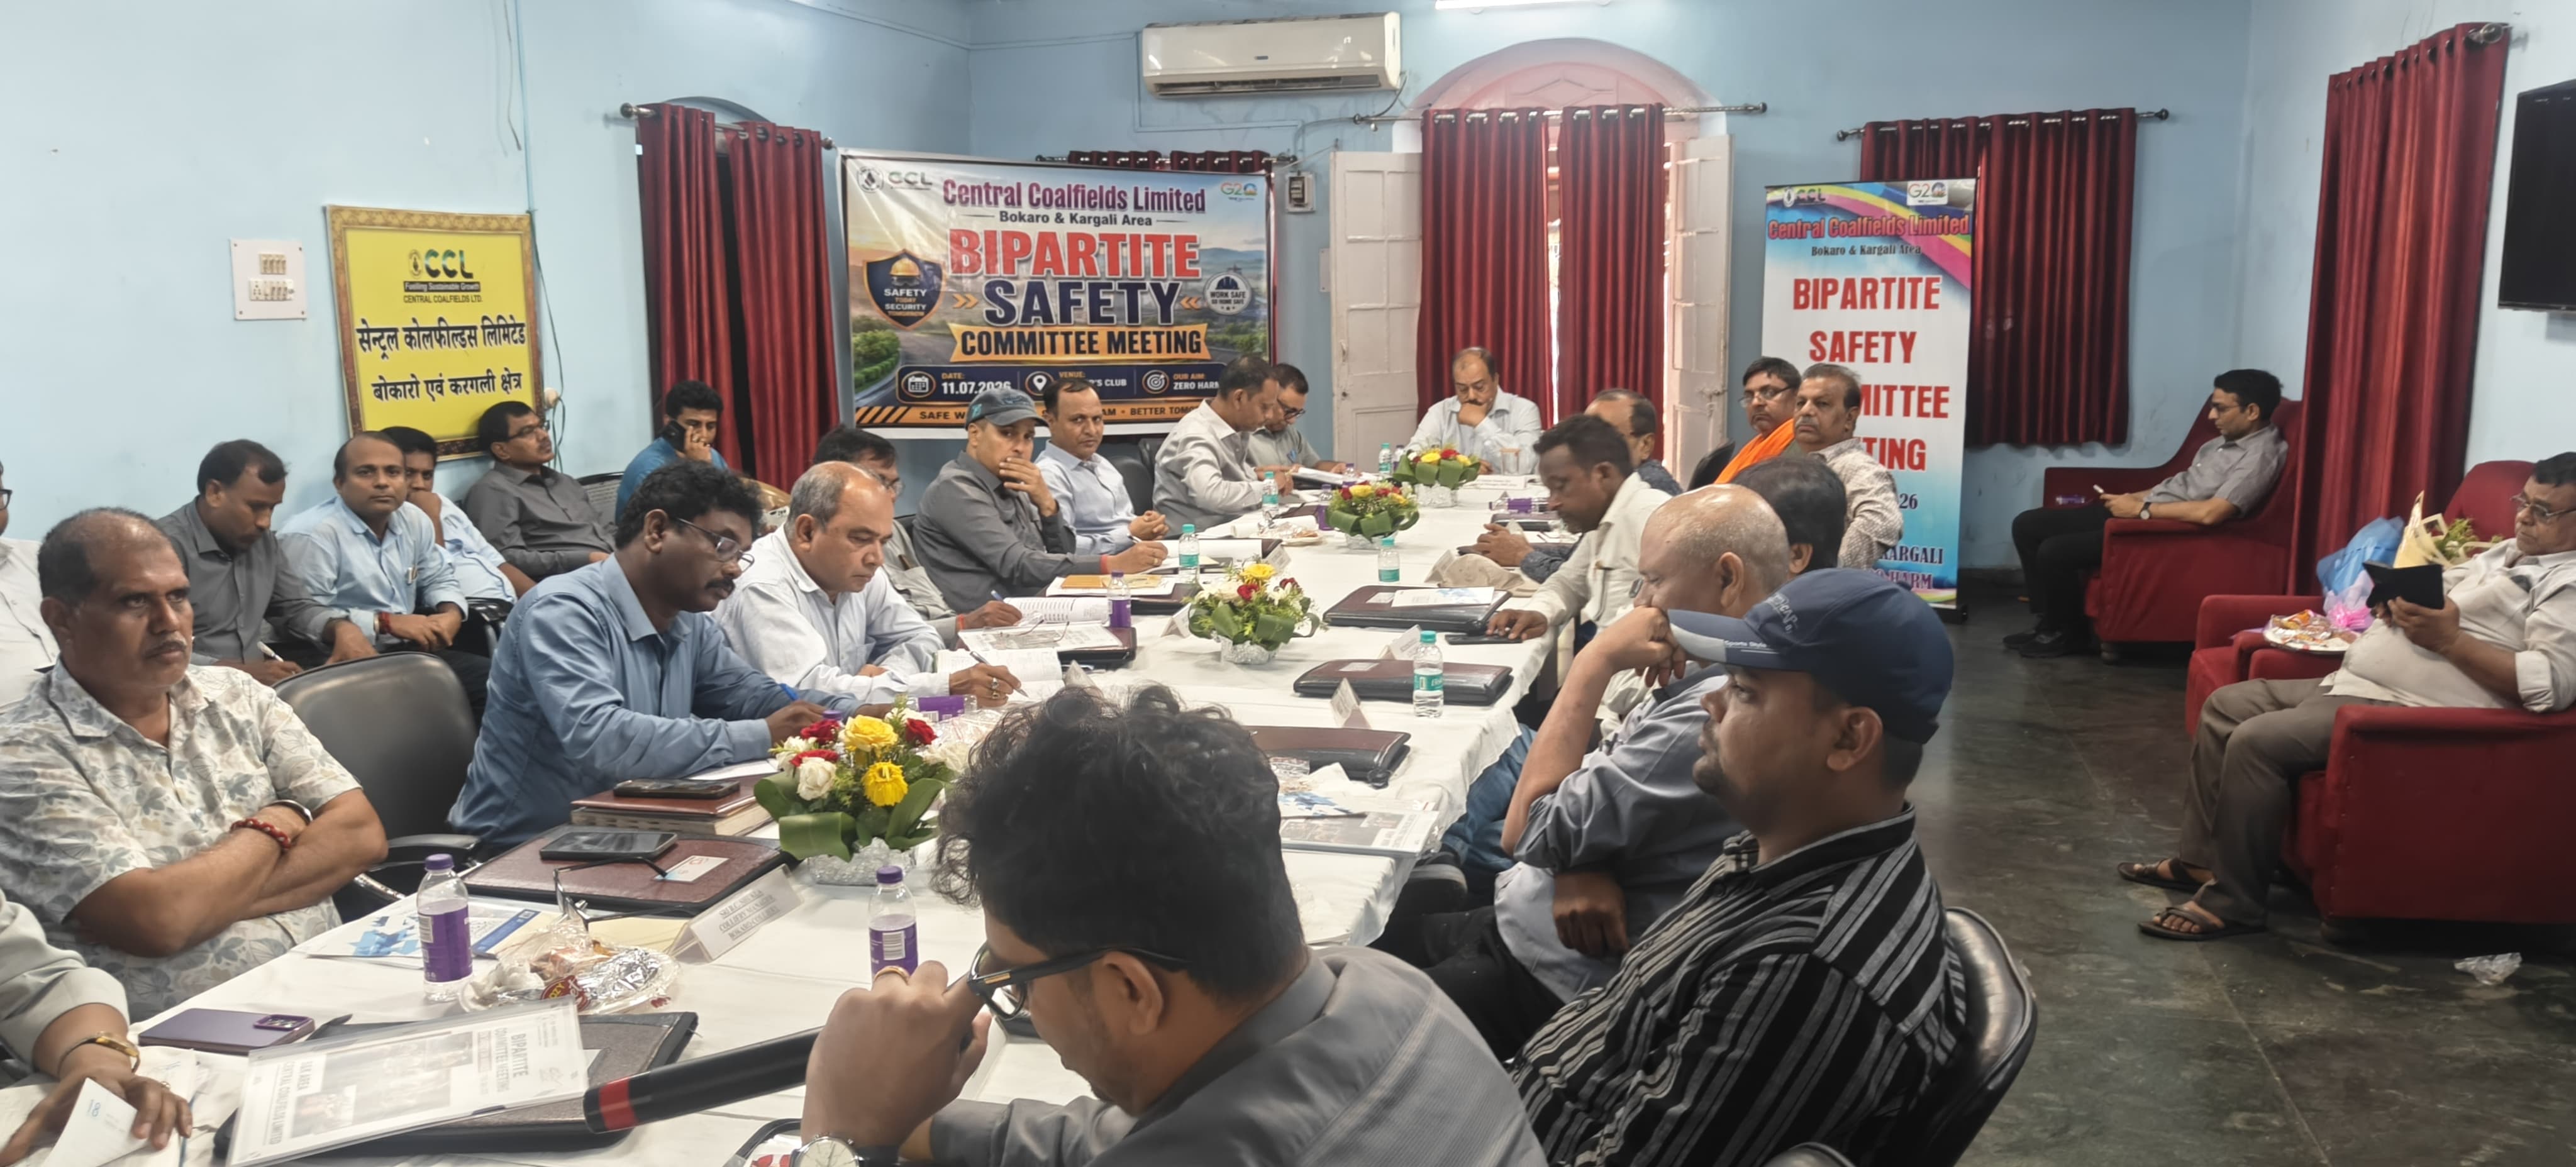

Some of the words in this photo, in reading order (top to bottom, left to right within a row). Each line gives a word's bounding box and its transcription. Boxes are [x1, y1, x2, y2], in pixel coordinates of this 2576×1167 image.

[888, 172, 933, 185] CCL
[943, 179, 1022, 208] Central
[1028, 182, 1128, 211] Coalfields
[1133, 186, 1206, 213] Limited
[1796, 188, 1826, 202] CCL
[999, 211, 1050, 223] Bokaro
[1055, 212, 1065, 224] &
[1070, 213, 1117, 227] Kargali
[1122, 214, 1152, 226] Area
[1768, 218, 1825, 240] Central
[1828, 216, 1906, 238] Coalfields
[1908, 214, 1970, 236] Limited
[425, 249, 474, 279] CCL
[949, 228, 1201, 277] BIPARTITE
[1811, 245, 1845, 256] Bokaro
[1849, 246, 1856, 255] &
[1860, 244, 1896, 256] Kargali
[1901, 244, 1921, 255] Area
[884, 289, 927, 297] SAFETY
[984, 279, 1182, 326] SAFETY
[1793, 277, 1941, 310] BIPARTITE
[480, 314, 525, 346] लिमिटेड
[961, 330, 1099, 355] COMMITTEE
[1107, 330, 1202, 354] MEETING
[1809, 331, 1917, 363] SAFETY
[371, 373, 420, 401] बोकारो
[423, 372, 444, 402] एवं
[448, 368, 496, 395] करगली
[501, 367, 523, 394] क्षेत्र
[1173, 382, 1196, 390] ZERO
[919, 411, 950, 419] SAFE
[1130, 407, 1165, 416] BETTER
[1860, 384, 1950, 418] MITTEE
[1862, 437, 1926, 471] TING
[549, 982, 564, 999] OZY
[511, 1033, 529, 1078] BIPARTITE
